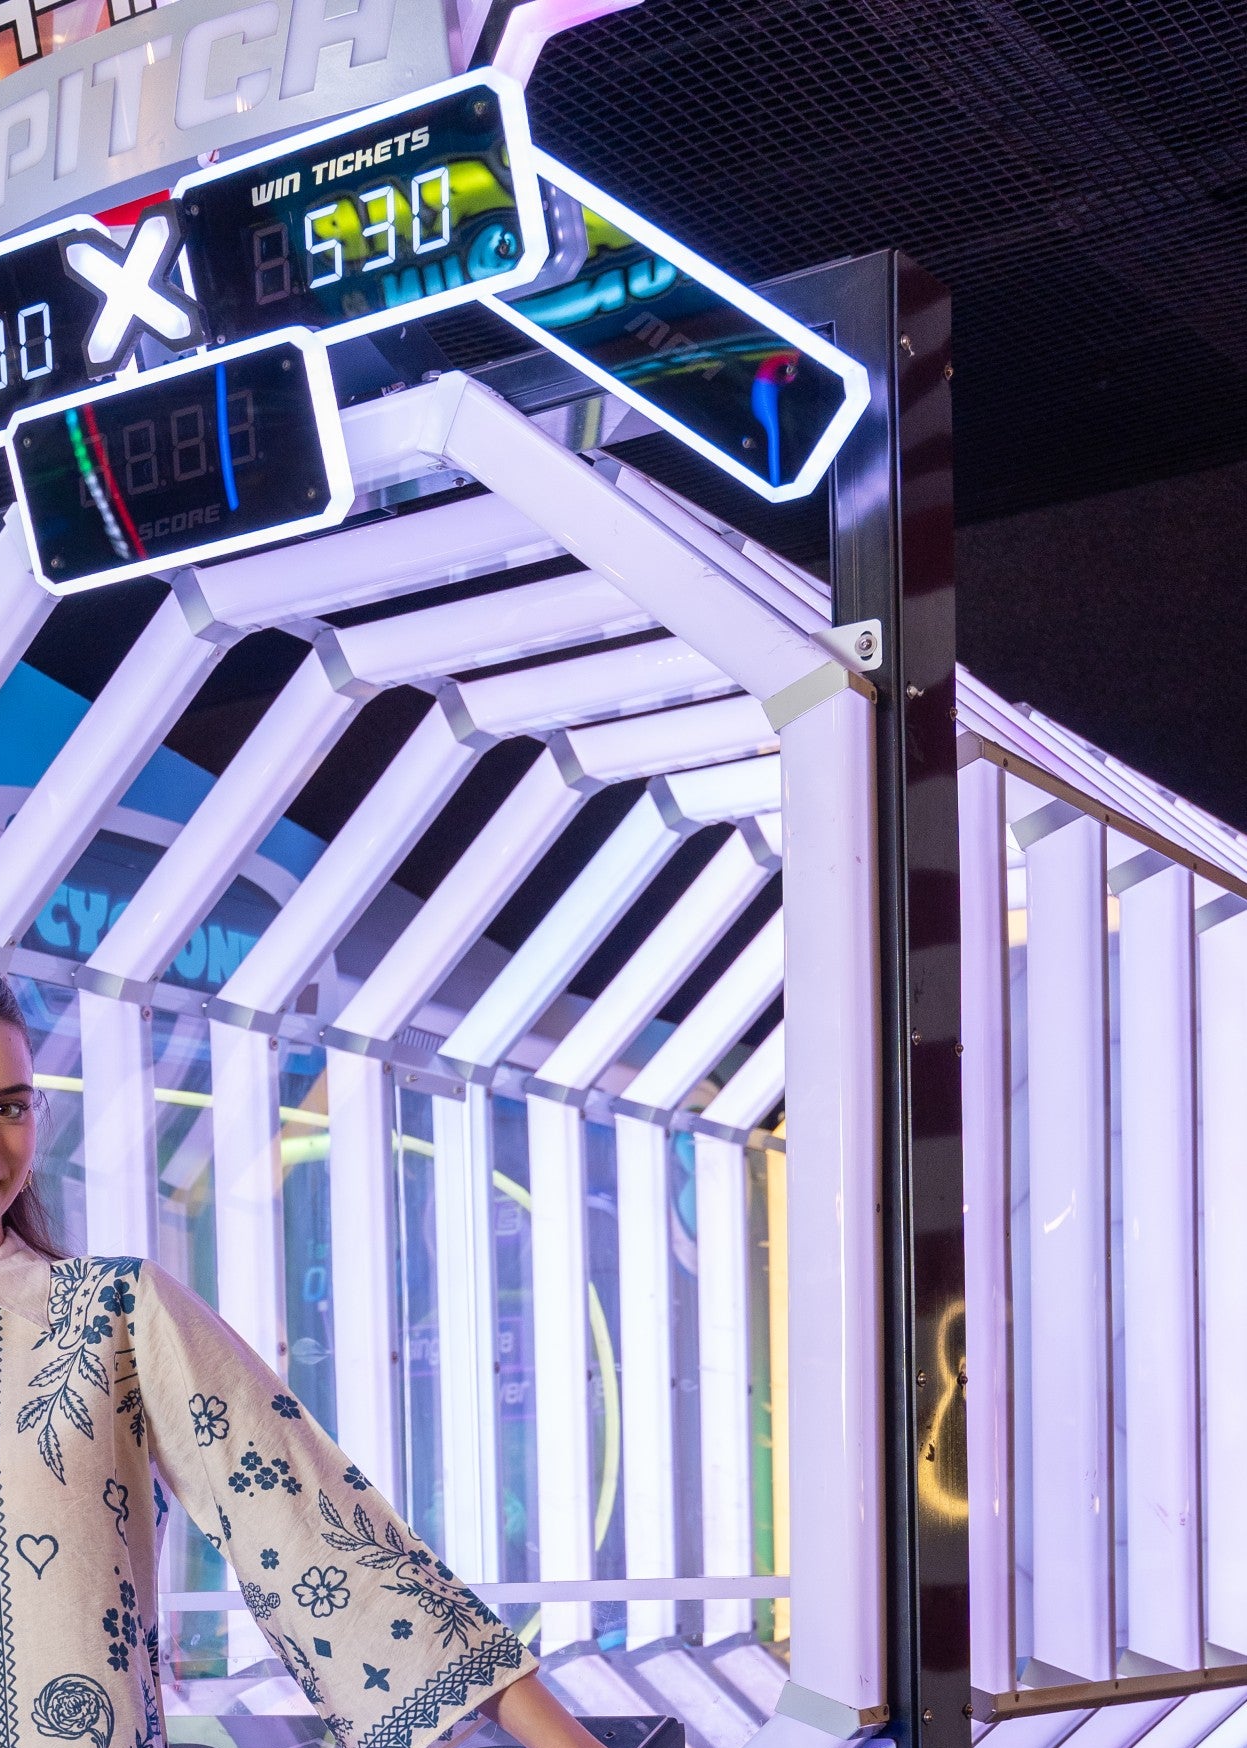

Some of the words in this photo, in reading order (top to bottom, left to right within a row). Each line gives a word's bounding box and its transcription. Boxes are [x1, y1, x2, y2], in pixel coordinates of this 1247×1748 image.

[251, 171, 301, 207] WIN
[312, 125, 430, 185] TICKETS
[304, 165, 450, 289] 530
[138, 502, 221, 541] SCORE
